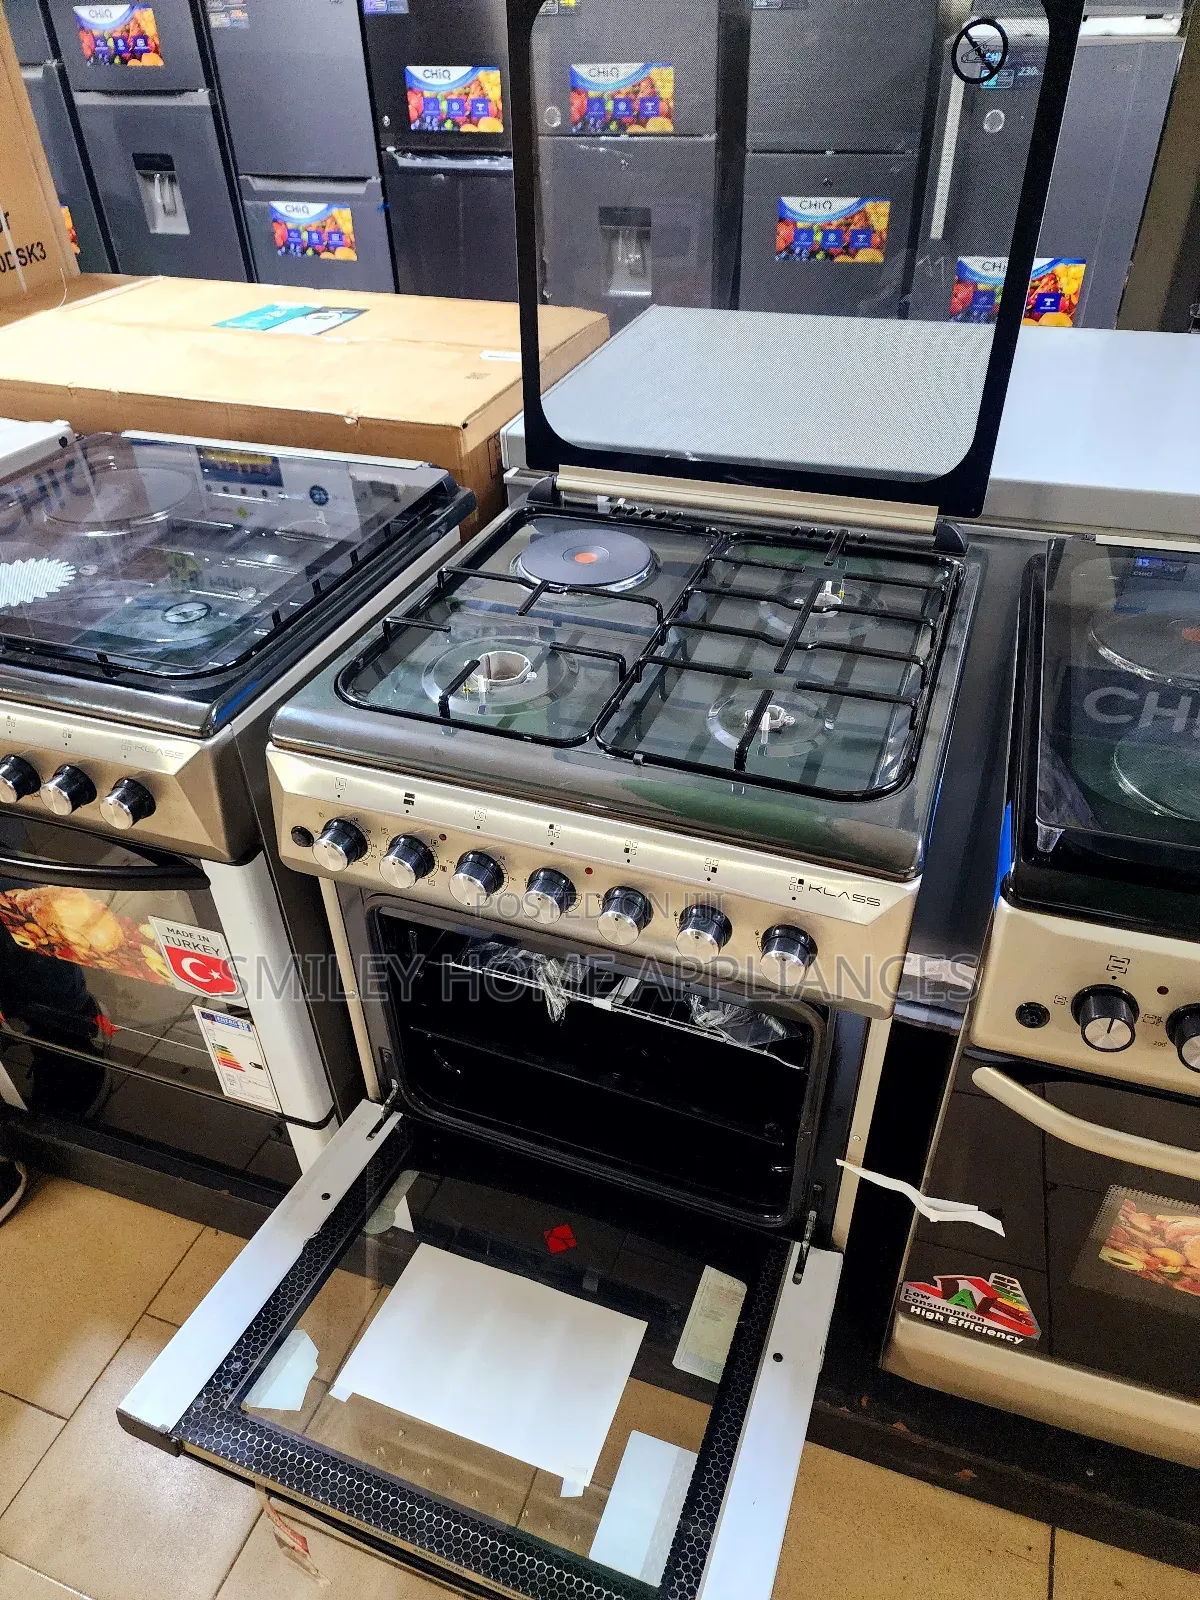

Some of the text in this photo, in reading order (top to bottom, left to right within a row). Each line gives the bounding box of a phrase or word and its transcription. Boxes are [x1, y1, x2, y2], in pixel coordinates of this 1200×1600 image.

[422, 68, 452, 80] CHiQ
[134, 744, 185, 760] KLASS
[807, 883, 881, 907] KLASS
[166, 927, 210, 943] MADE IN
[162, 934, 220, 956] TURKEY
[905, 1287, 931, 1300] Low
[903, 1294, 985, 1323] Consumption
[910, 1305, 1024, 1345] High Efficiency
